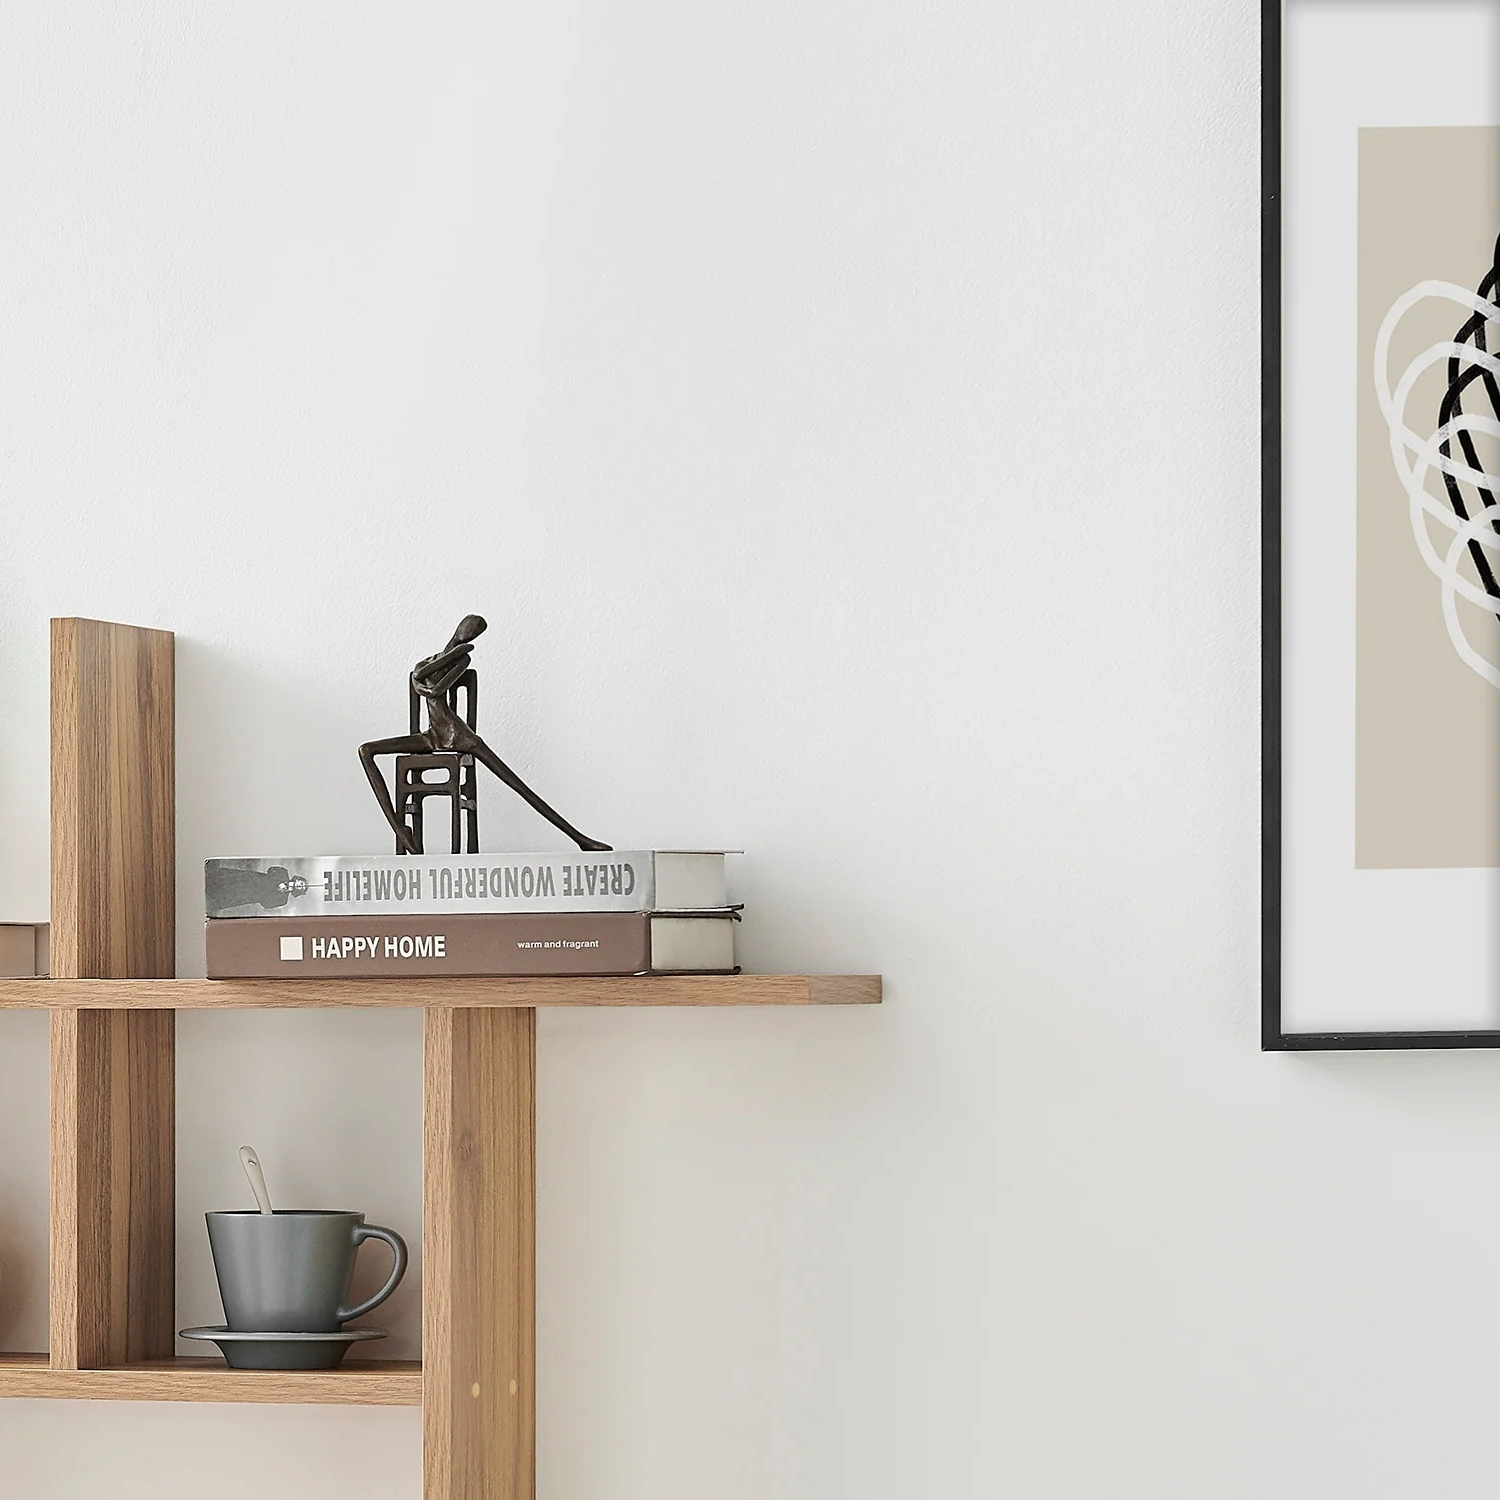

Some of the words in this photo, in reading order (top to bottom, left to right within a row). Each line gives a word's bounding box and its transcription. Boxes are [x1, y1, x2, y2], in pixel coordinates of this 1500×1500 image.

[323, 869, 422, 902] HOMELIFE
[428, 865, 556, 900] WONDERFUL
[563, 863, 636, 896] CREATE
[311, 936, 380, 959] HAPPY
[384, 935, 447, 958] HOME
[517, 941, 542, 949] warm
[544, 940, 561, 949] and
[563, 940, 599, 951] fragrant
